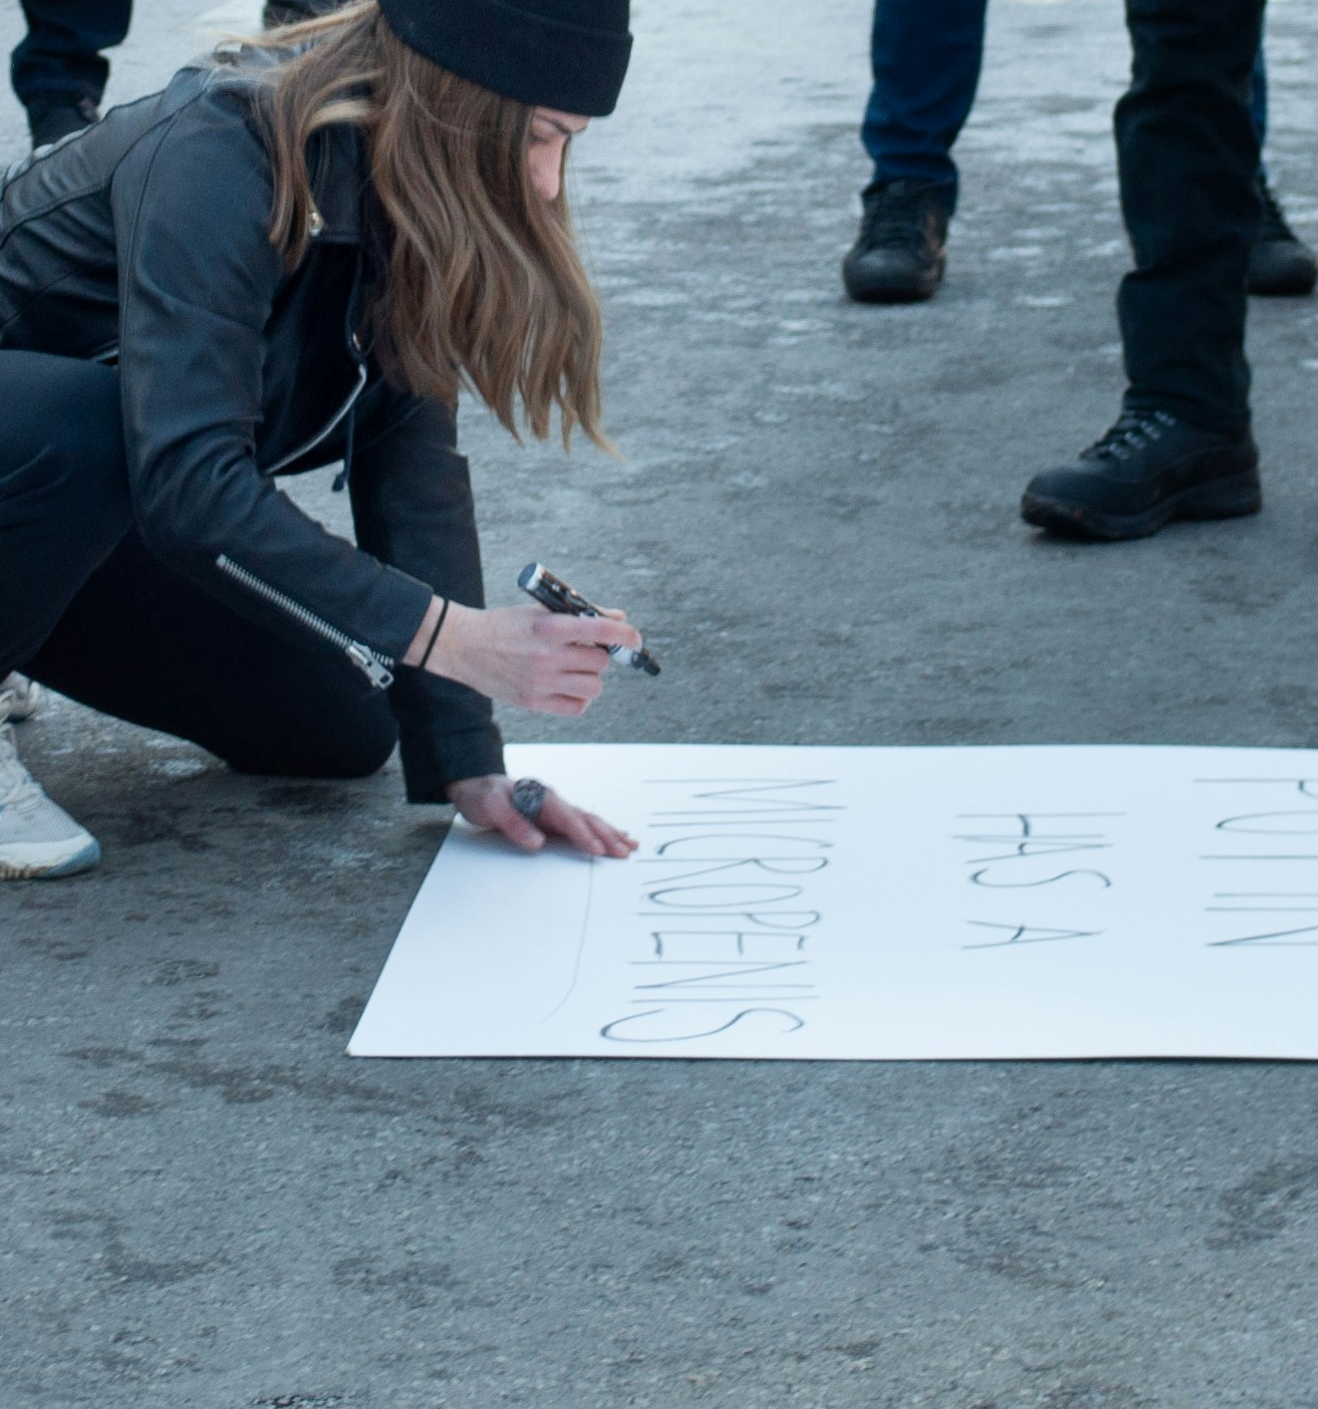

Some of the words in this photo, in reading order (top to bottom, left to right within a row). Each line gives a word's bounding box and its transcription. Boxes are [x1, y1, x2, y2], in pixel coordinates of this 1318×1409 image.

[950, 811, 1128, 889] HAS
[599, 777, 847, 1043] MICROPENIS
[959, 918, 1107, 951] A
